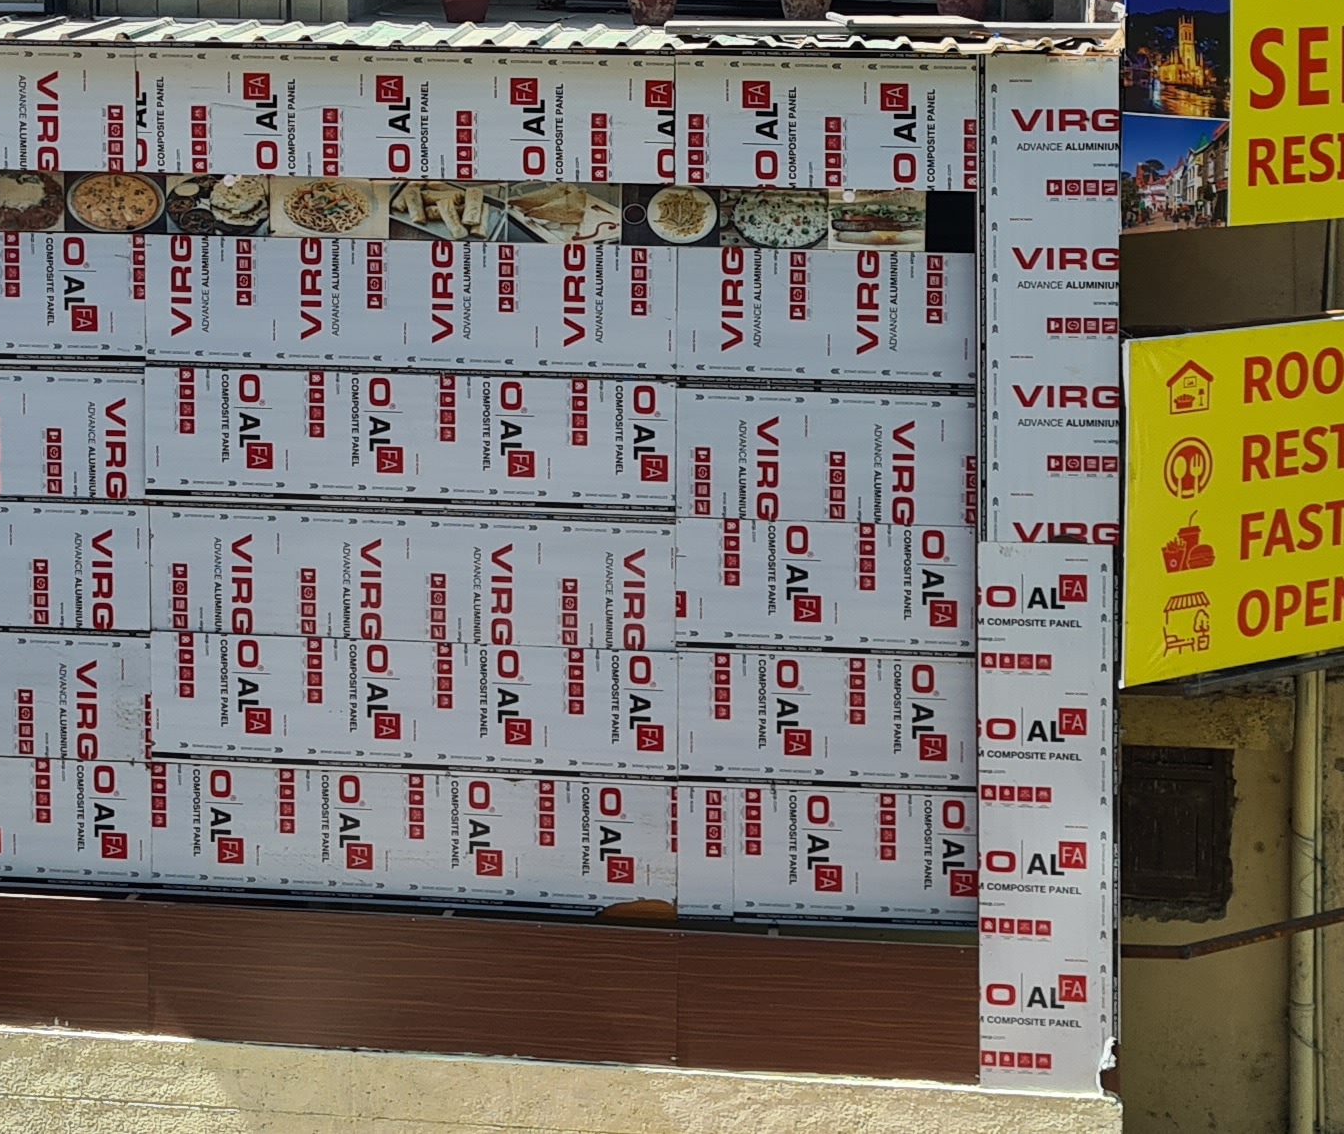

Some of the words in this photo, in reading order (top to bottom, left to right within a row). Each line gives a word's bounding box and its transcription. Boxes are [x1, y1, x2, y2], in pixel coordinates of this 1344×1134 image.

[37, 70, 60, 173] VIRG
[287, 77, 296, 111] PANEL
[926, 88, 936, 122] PANEL
[1010, 109, 1120, 132] VIRG
[287, 112, 296, 167] COMPOSITE
[926, 123, 936, 179] COMPOSITE
[1016, 142, 1063, 152] ADVANCE
[171, 236, 193, 337] VIRG
[1011, 247, 1120, 270] VIRG
[1016, 280, 1064, 290] ADVANCE
[300, 238, 323, 341] VIRG
[331, 292, 340, 337] ADVANCE
[431, 241, 454, 344] VIRG
[563, 244, 587, 348] VIRG
[721, 248, 744, 353] VIRG
[857, 251, 881, 356] VIRG
[482, 381, 491, 438] COMPOSITE
[1012, 385, 1121, 408] VIRG
[1017, 418, 1064, 428] ADVANCE
[105, 397, 128, 500] VIRG
[482, 440, 491, 472] PANEL
[738, 419, 748, 464] ADVANCE
[757, 416, 780, 521] VIRG
[892, 420, 915, 525] VIRG
[92, 529, 114, 631] VIRG
[231, 533, 254, 634] VIRG
[472, 546, 482, 590] ADVANCE
[903, 529, 912, 587] COMPOSITE
[360, 538, 383, 640] VIRG
[491, 543, 513, 646] VIRG
[623, 548, 646, 650] VIRG
[903, 588, 912, 621] PANEL
[986, 617, 1047, 629] COMPOSITE
[1048, 617, 1083, 629] PANEL
[219, 638, 229, 695] COMPOSITE
[76, 660, 99, 761] VIRG
[219, 696, 229, 728] PANEL
[986, 750, 1047, 762] COMPOSITE
[1048, 750, 1083, 762] PANEL
[986, 882, 1047, 895] COMPOSITE
[1048, 882, 1082, 895] PANEL
[986, 1015, 1047, 1028] COMPOSITE
[1048, 1015, 1082, 1028] PANEL
